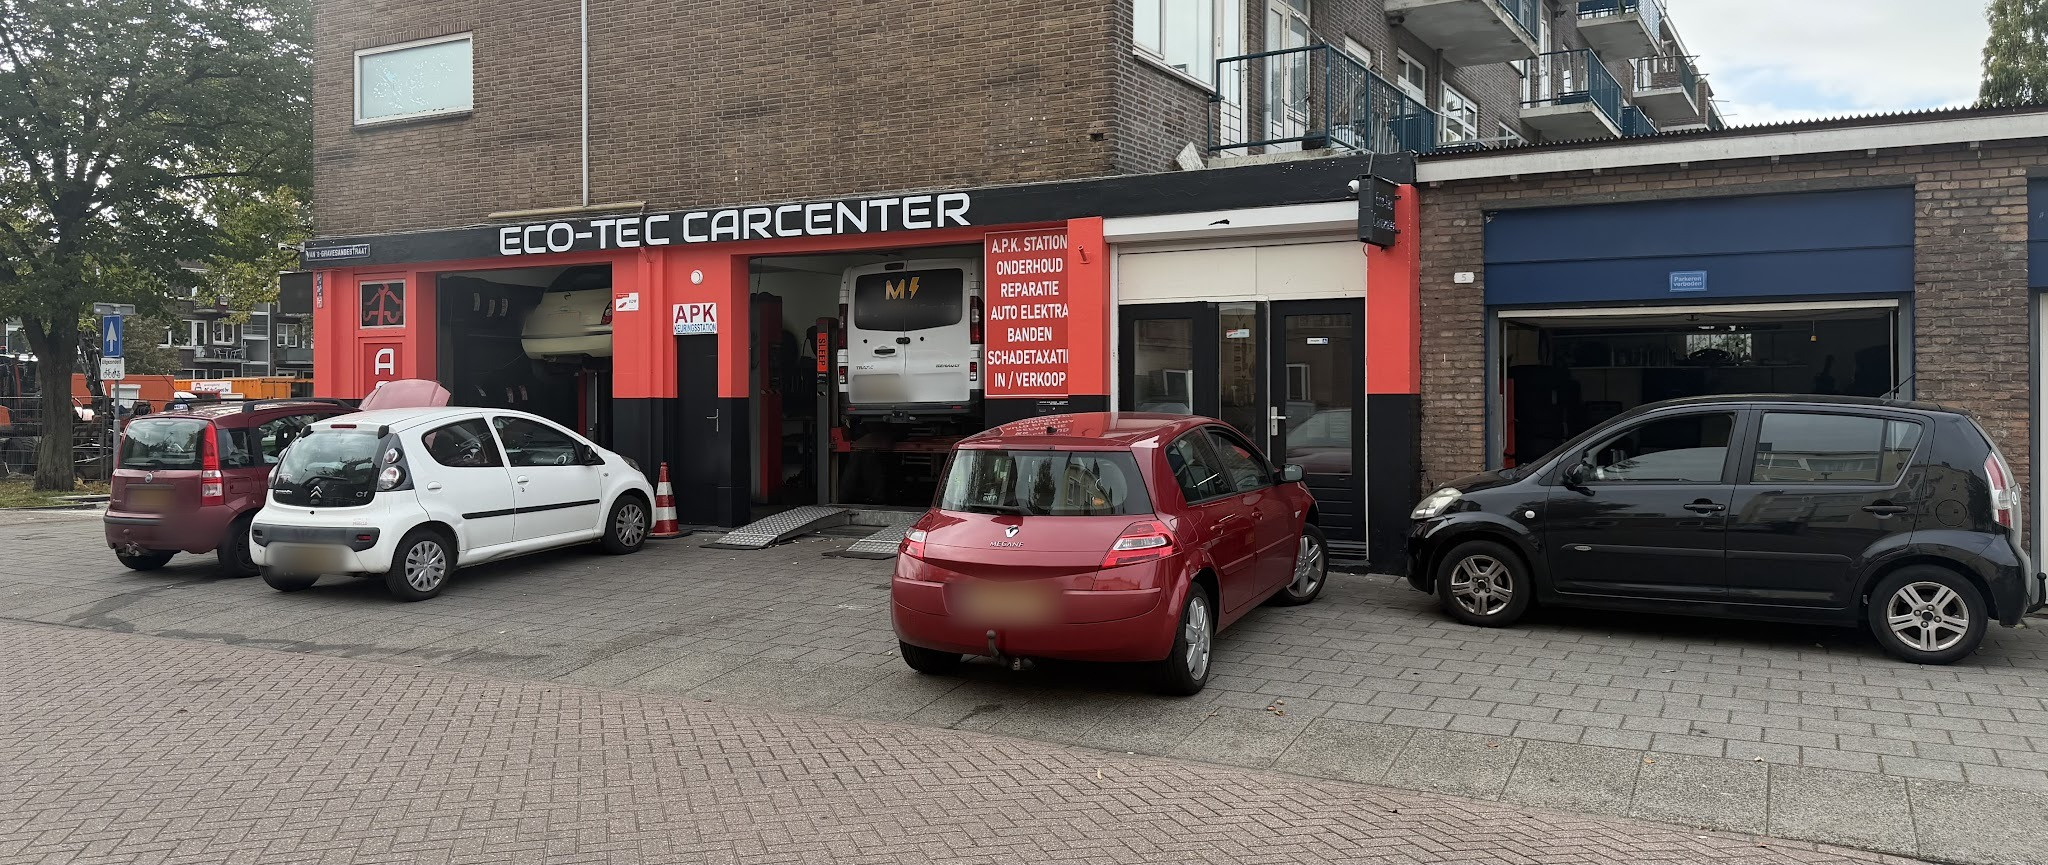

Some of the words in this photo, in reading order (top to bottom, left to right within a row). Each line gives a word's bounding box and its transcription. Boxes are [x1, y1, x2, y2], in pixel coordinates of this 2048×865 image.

[500, 214, 670, 256] ECO-TEC
[683, 193, 972, 243] CARCENTER
[991, 237, 1021, 254] A.P.K.
[1023, 234, 1068, 252] STATION
[996, 257, 1063, 276] ONDERHOUD
[885, 278, 905, 300] M
[1000, 280, 1060, 298] REPARATIE
[674, 303, 715, 324] APK
[990, 305, 1018, 320] AUTO
[1020, 303, 1069, 320] ELEKTRA
[674, 323, 717, 333] KEURINGSSTATION
[1007, 326, 1053, 342] BANDEN
[818, 338, 826, 367] SLEEP
[994, 372, 1006, 388] IN
[1008, 370, 1014, 390] /
[1016, 372, 1067, 387] VERKOOP
